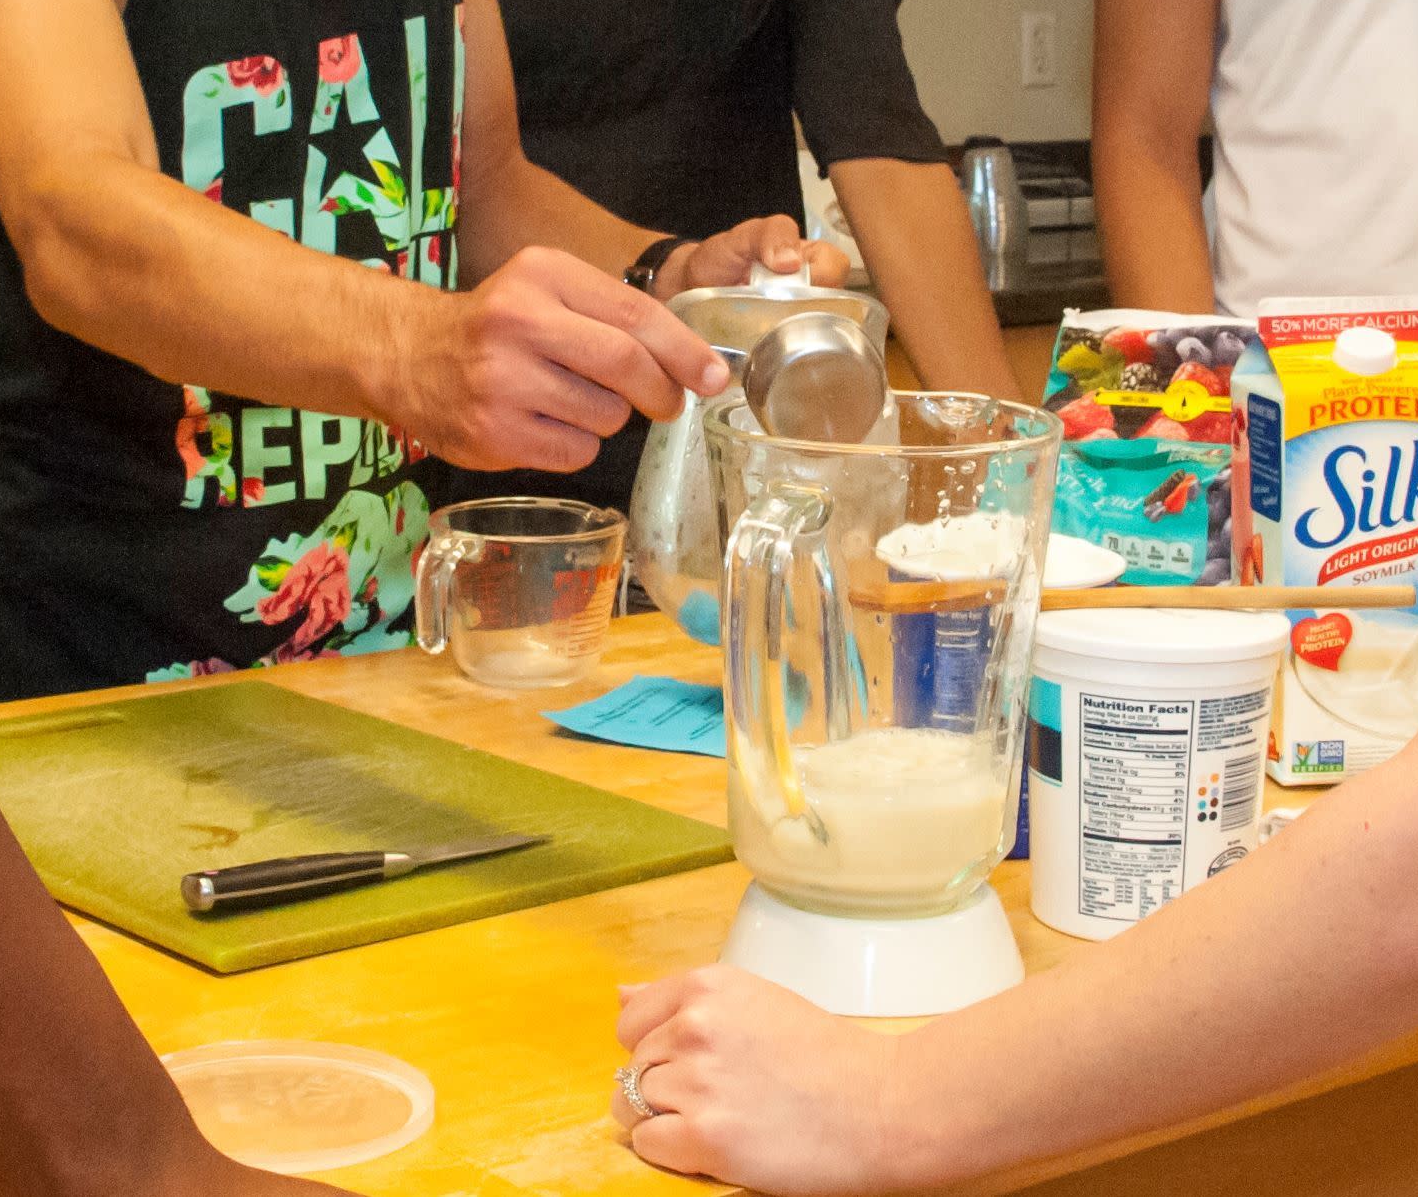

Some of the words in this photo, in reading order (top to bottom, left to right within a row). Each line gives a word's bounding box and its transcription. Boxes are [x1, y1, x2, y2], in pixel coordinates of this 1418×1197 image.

[1271, 318, 1301, 334] 50%
[1303, 317, 1349, 332] MORE
[1325, 547, 1369, 575] LIGHT
[1351, 560, 1416, 586] SOYMILK
[1300, 636, 1346, 653] PROTEIN
[1083, 696, 1144, 714] Nutrition
[1148, 703, 1189, 714] Facts
[1319, 749, 1343, 758] GMO
[1320, 741, 1343, 750] NON
[1292, 764, 1343, 772] VERIFIED
